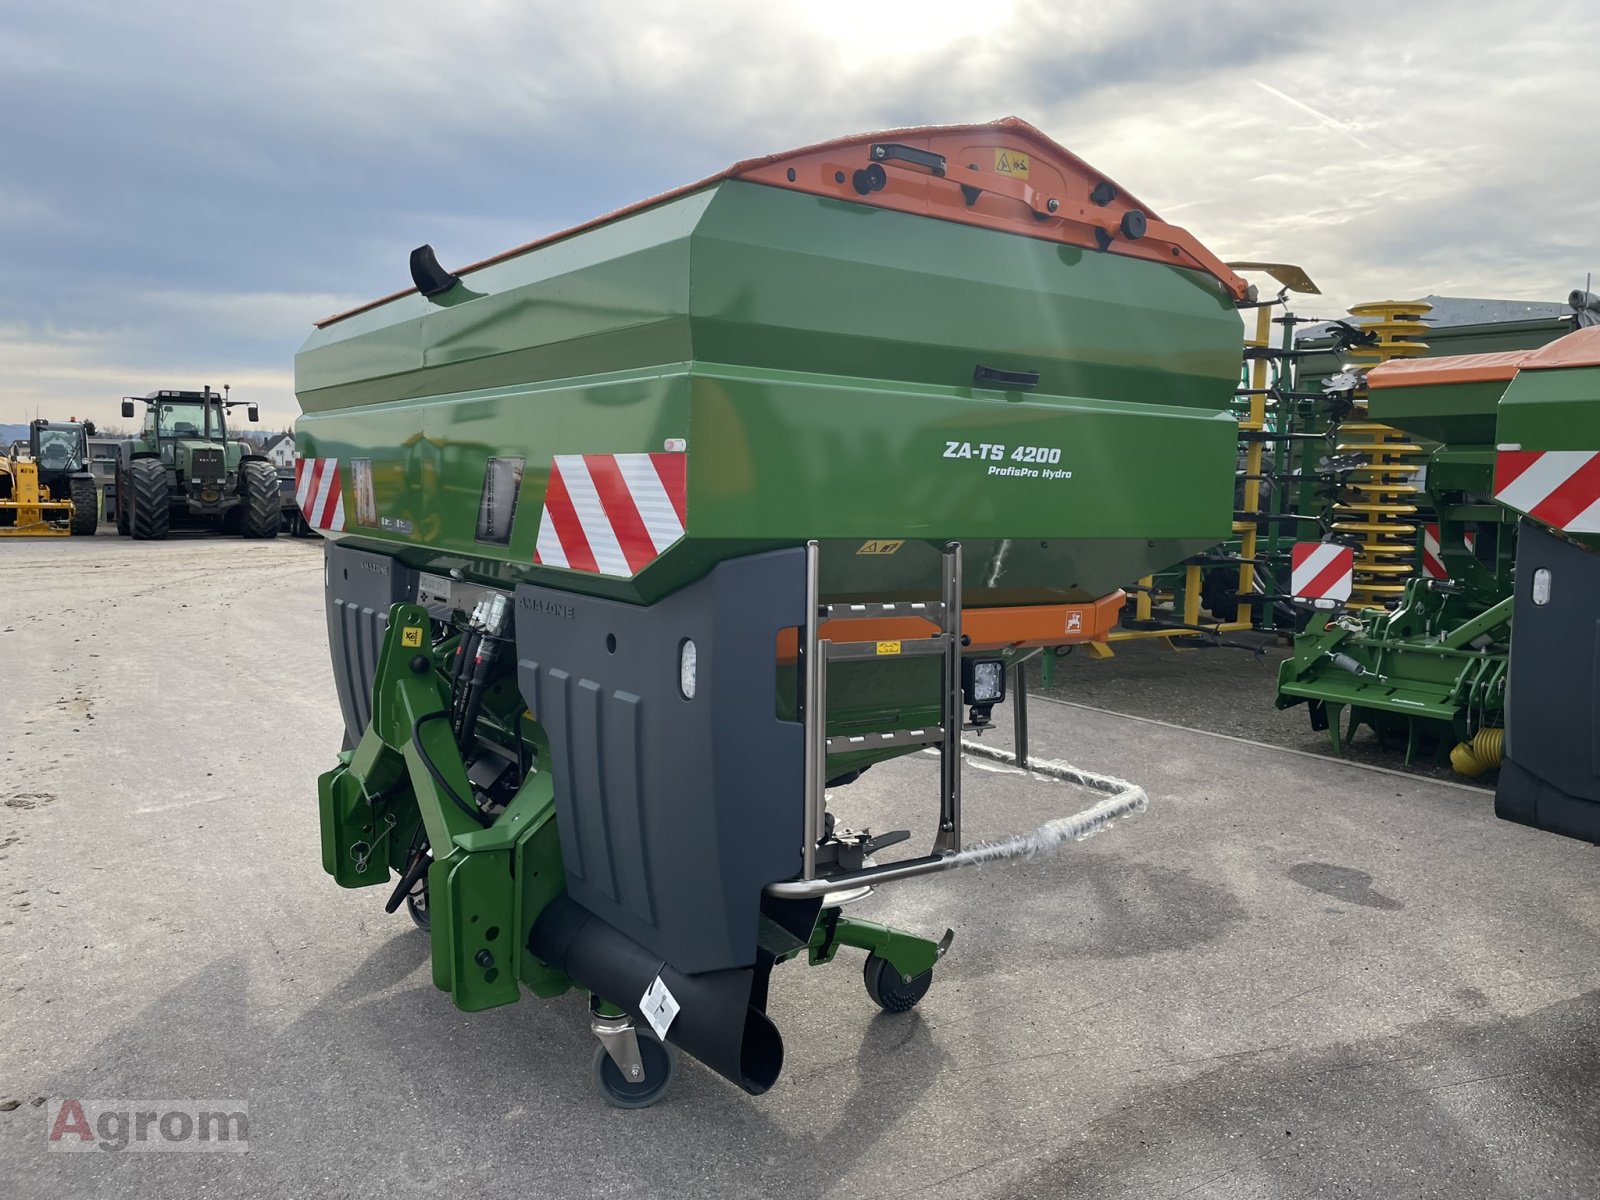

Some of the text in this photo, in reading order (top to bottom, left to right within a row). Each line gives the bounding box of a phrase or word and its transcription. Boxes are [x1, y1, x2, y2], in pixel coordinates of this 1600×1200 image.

[943, 441, 1061, 464] ZA-TS 4200
[988, 465, 1072, 480] ProfisPro Hydro
[518, 596, 576, 620] AMAZONE
